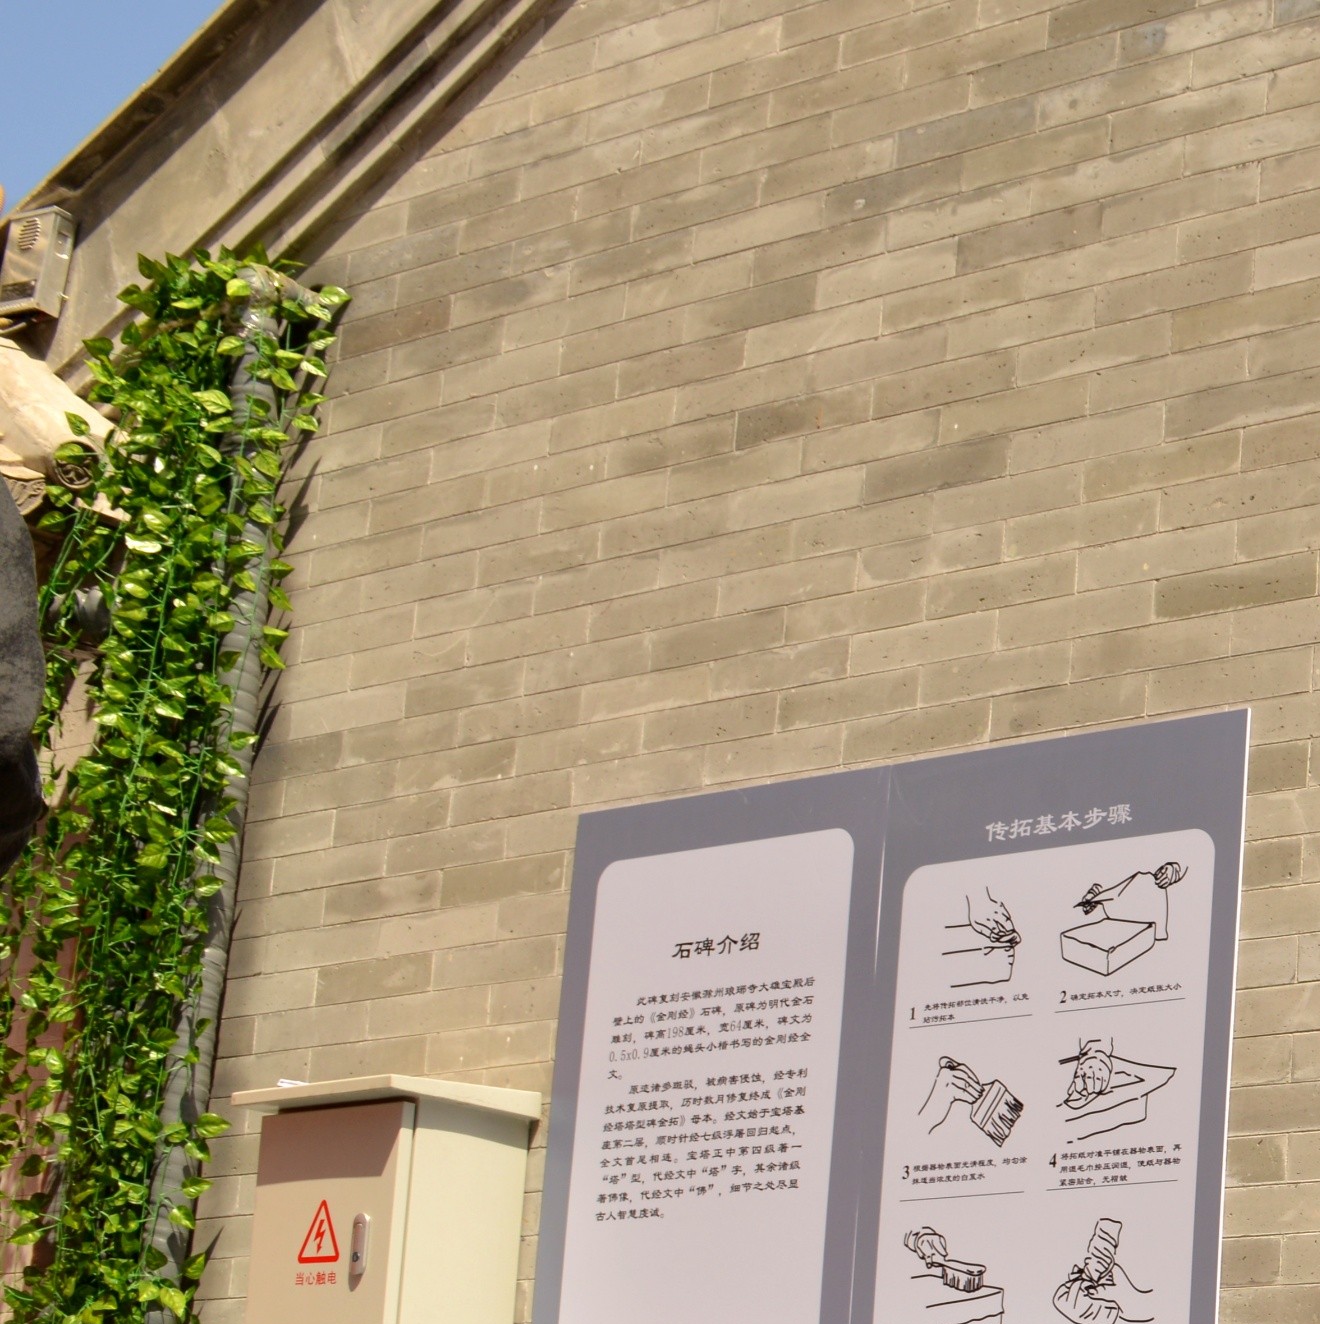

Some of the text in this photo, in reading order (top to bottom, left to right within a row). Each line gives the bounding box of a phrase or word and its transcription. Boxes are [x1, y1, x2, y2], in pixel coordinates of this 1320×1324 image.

[985, 803, 1133, 842] 传拓基本步骤
[671, 932, 761, 959] 石碑介绍
[1059, 990, 1067, 1004] 2
[909, 1006, 916, 1020] 1
[1049, 1153, 1057, 1168] 4
[902, 1165, 910, 1180] 3
[295, 1271, 337, 1286] 当心触电
